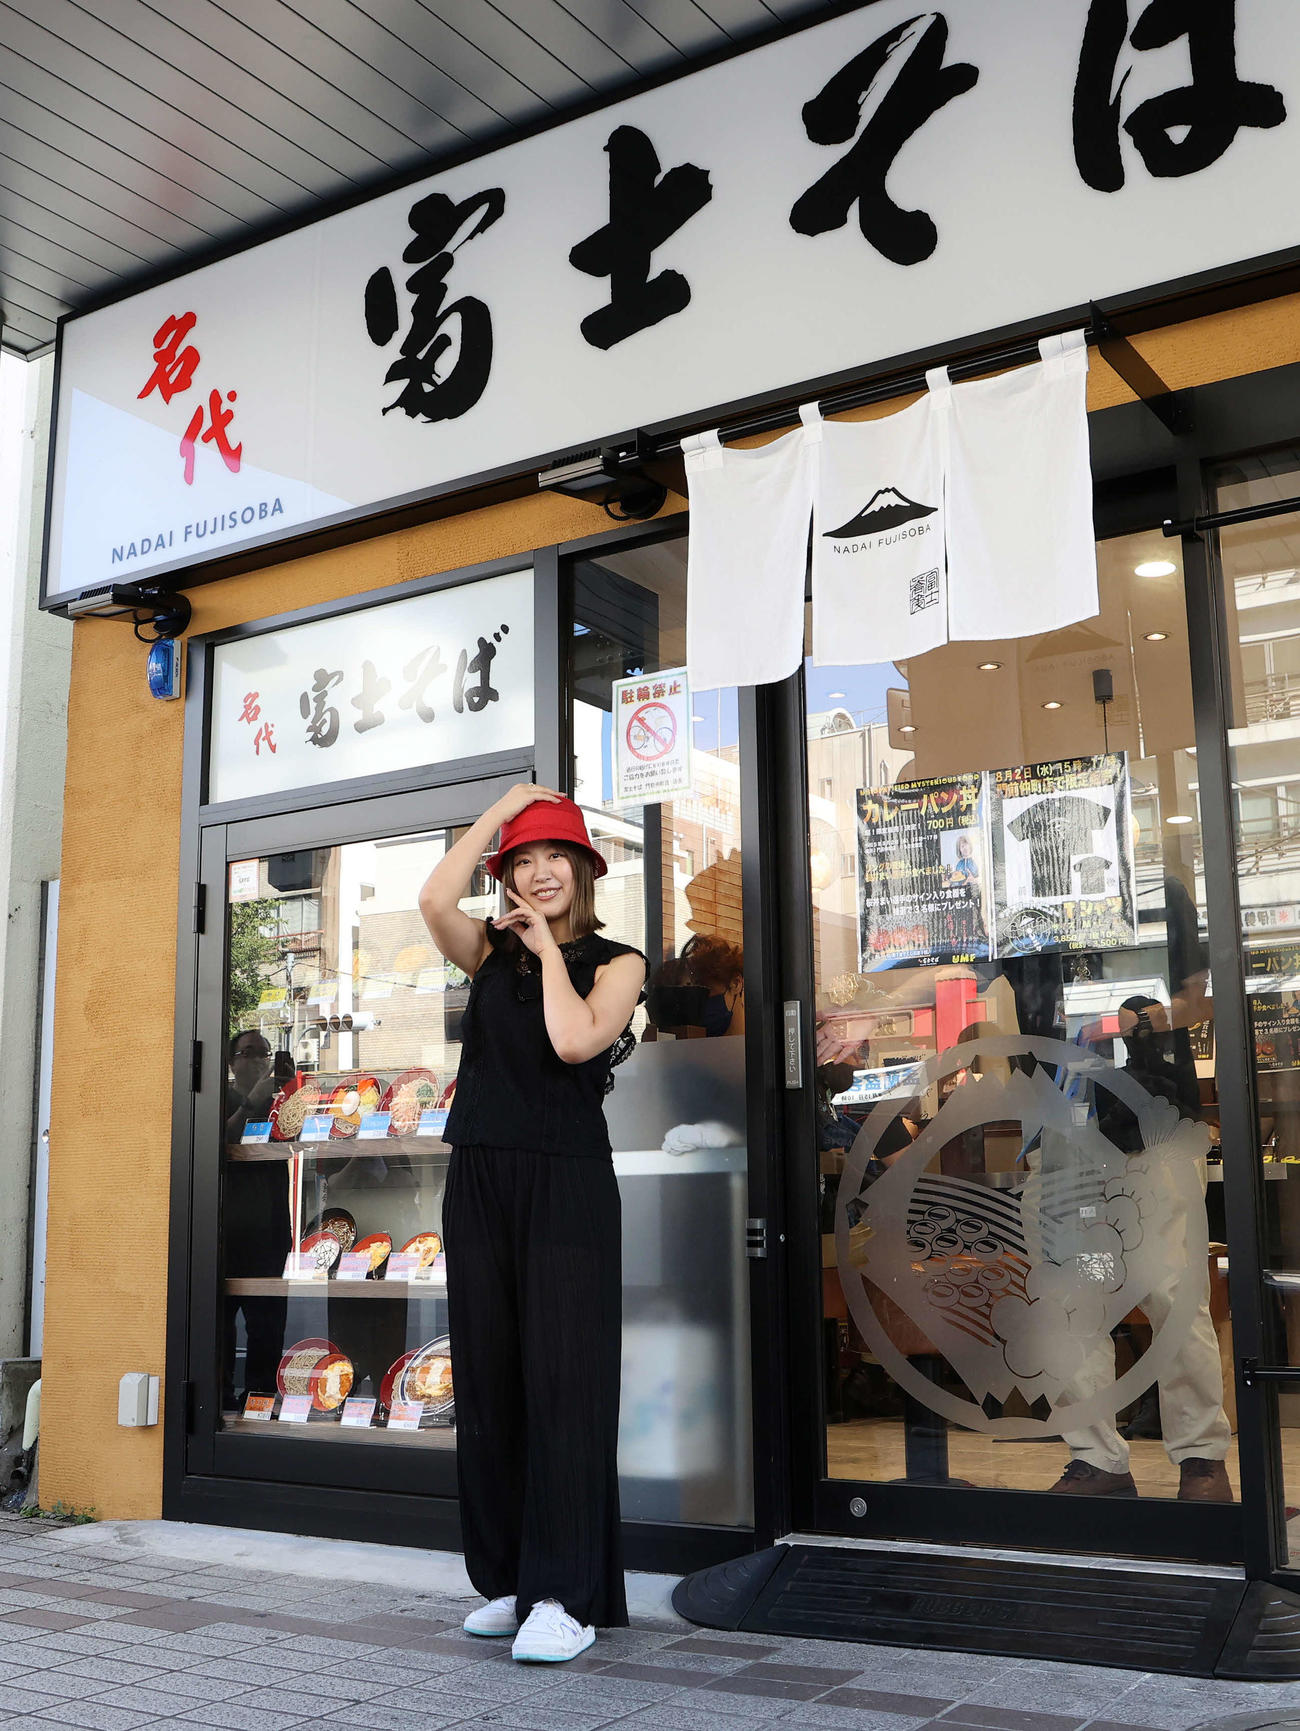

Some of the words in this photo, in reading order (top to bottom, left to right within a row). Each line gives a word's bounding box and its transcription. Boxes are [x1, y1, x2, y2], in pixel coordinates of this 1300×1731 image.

[137, 311, 242, 485] 名代
[111, 532, 174, 565] NADAI
[183, 497, 285, 543] FUJISOBA
[833, 541, 873, 555] NADAI
[878, 523, 932, 548] FUJISOBA
[299, 623, 510, 748] 富士そば
[621, 680, 683, 705] 駐輪禁止
[238, 691, 278, 756] 名代
[862, 785, 979, 824] カレーパン丼
[911, 778, 957, 790] MYSTERIOUS
